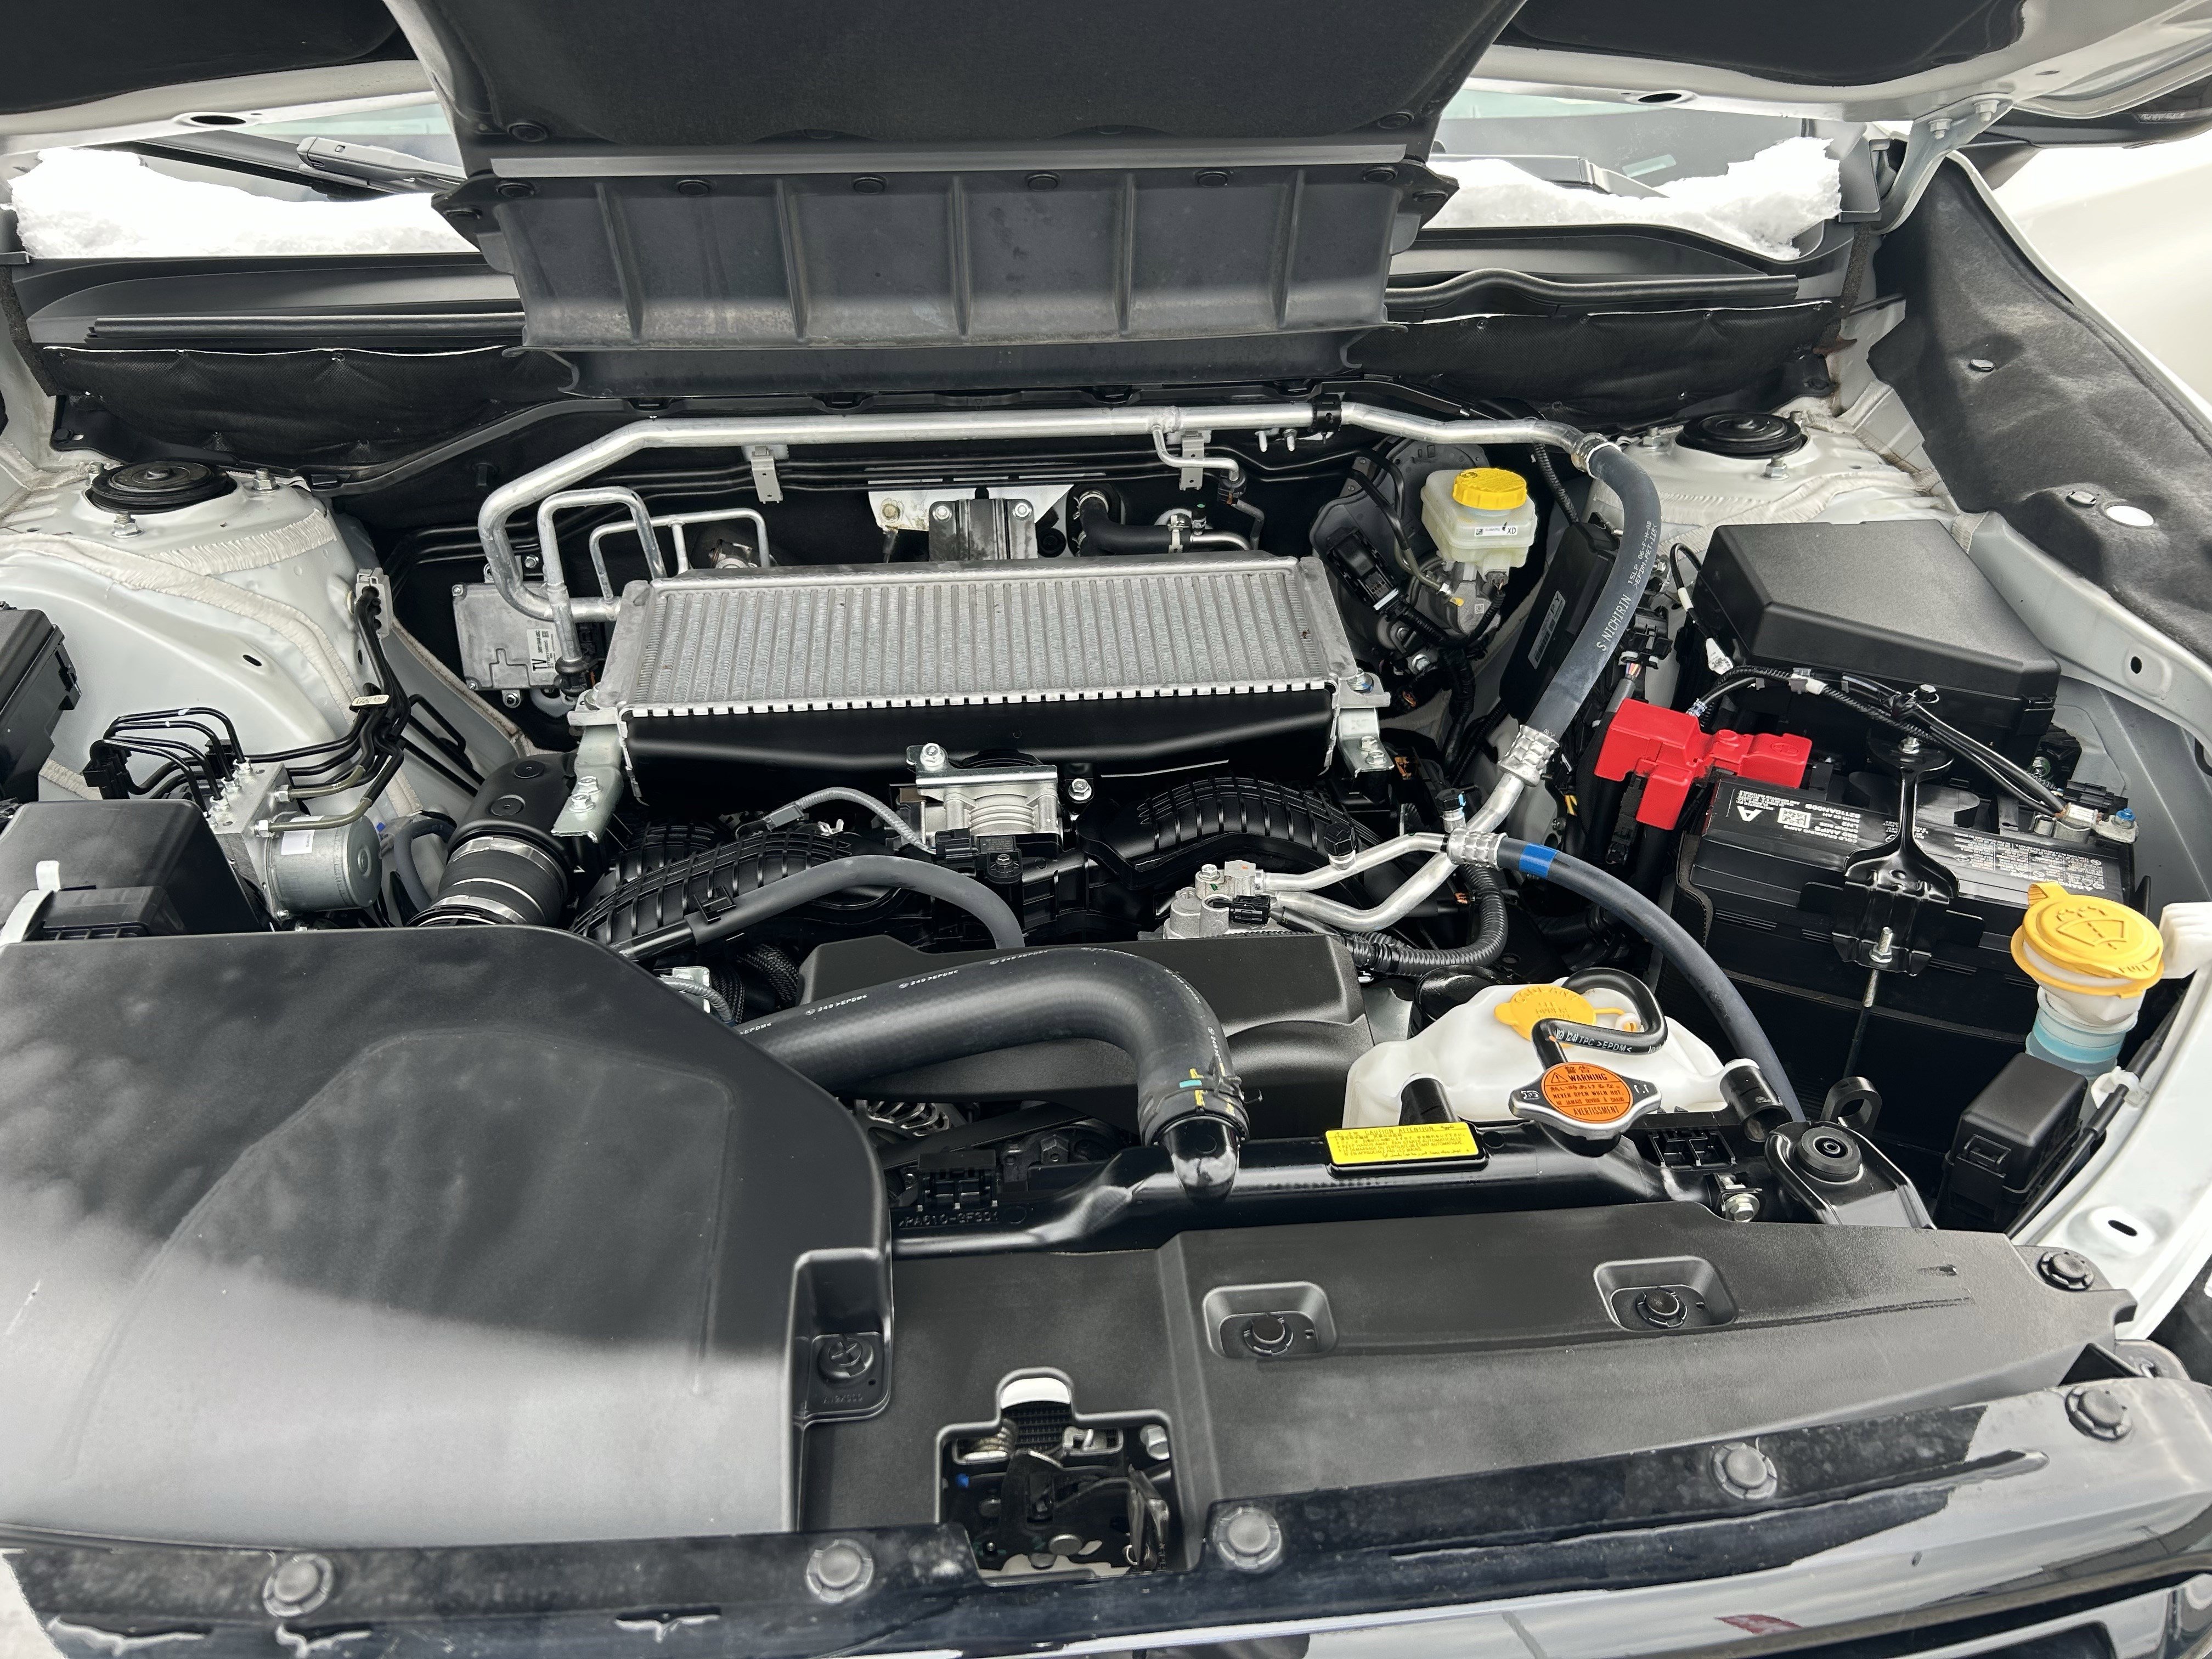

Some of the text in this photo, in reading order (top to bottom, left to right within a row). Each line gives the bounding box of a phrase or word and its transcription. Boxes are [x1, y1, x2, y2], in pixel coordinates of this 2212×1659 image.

[1628, 564, 1639, 585] 15LP
[532, 658, 548, 671] TV
[1737, 806, 1762, 822] A
[1803, 829, 1838, 839] CRANKING
[1814, 826, 1841, 835] AMPS
[835, 994, 868, 1007] >EPDM<
[1579, 1036, 1594, 1046] TPC
[1597, 1040, 1632, 1052] >EPDM<
[1565, 1065, 1590, 1074] 警告
[1567, 1073, 1607, 1082] WARNING
[1573, 1106, 1620, 1116] AVERTISSMENT
